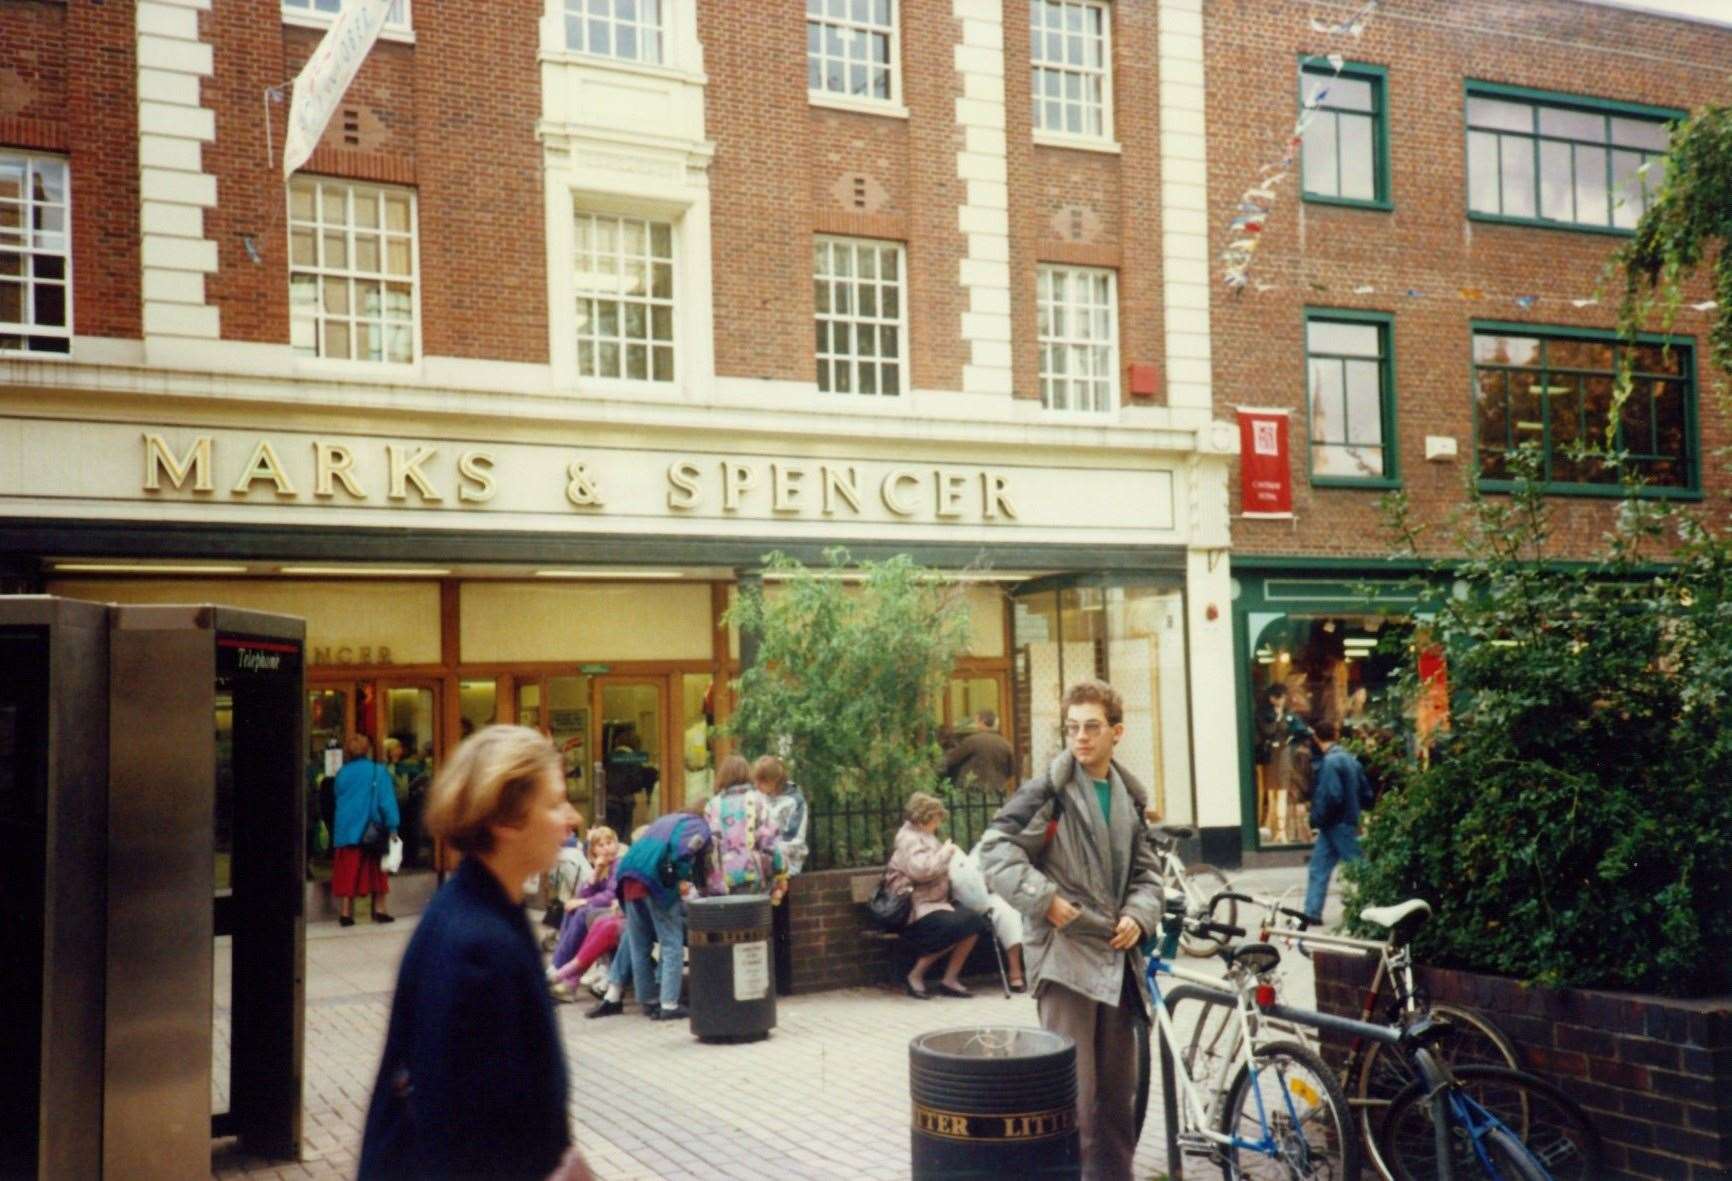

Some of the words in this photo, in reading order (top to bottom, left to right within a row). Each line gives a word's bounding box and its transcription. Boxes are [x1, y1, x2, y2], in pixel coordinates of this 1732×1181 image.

[142, 433, 497, 503] MARKS
[566, 459, 605, 509] &
[667, 460, 1018, 522] SPENCER
[237, 648, 281, 672] Telephone
